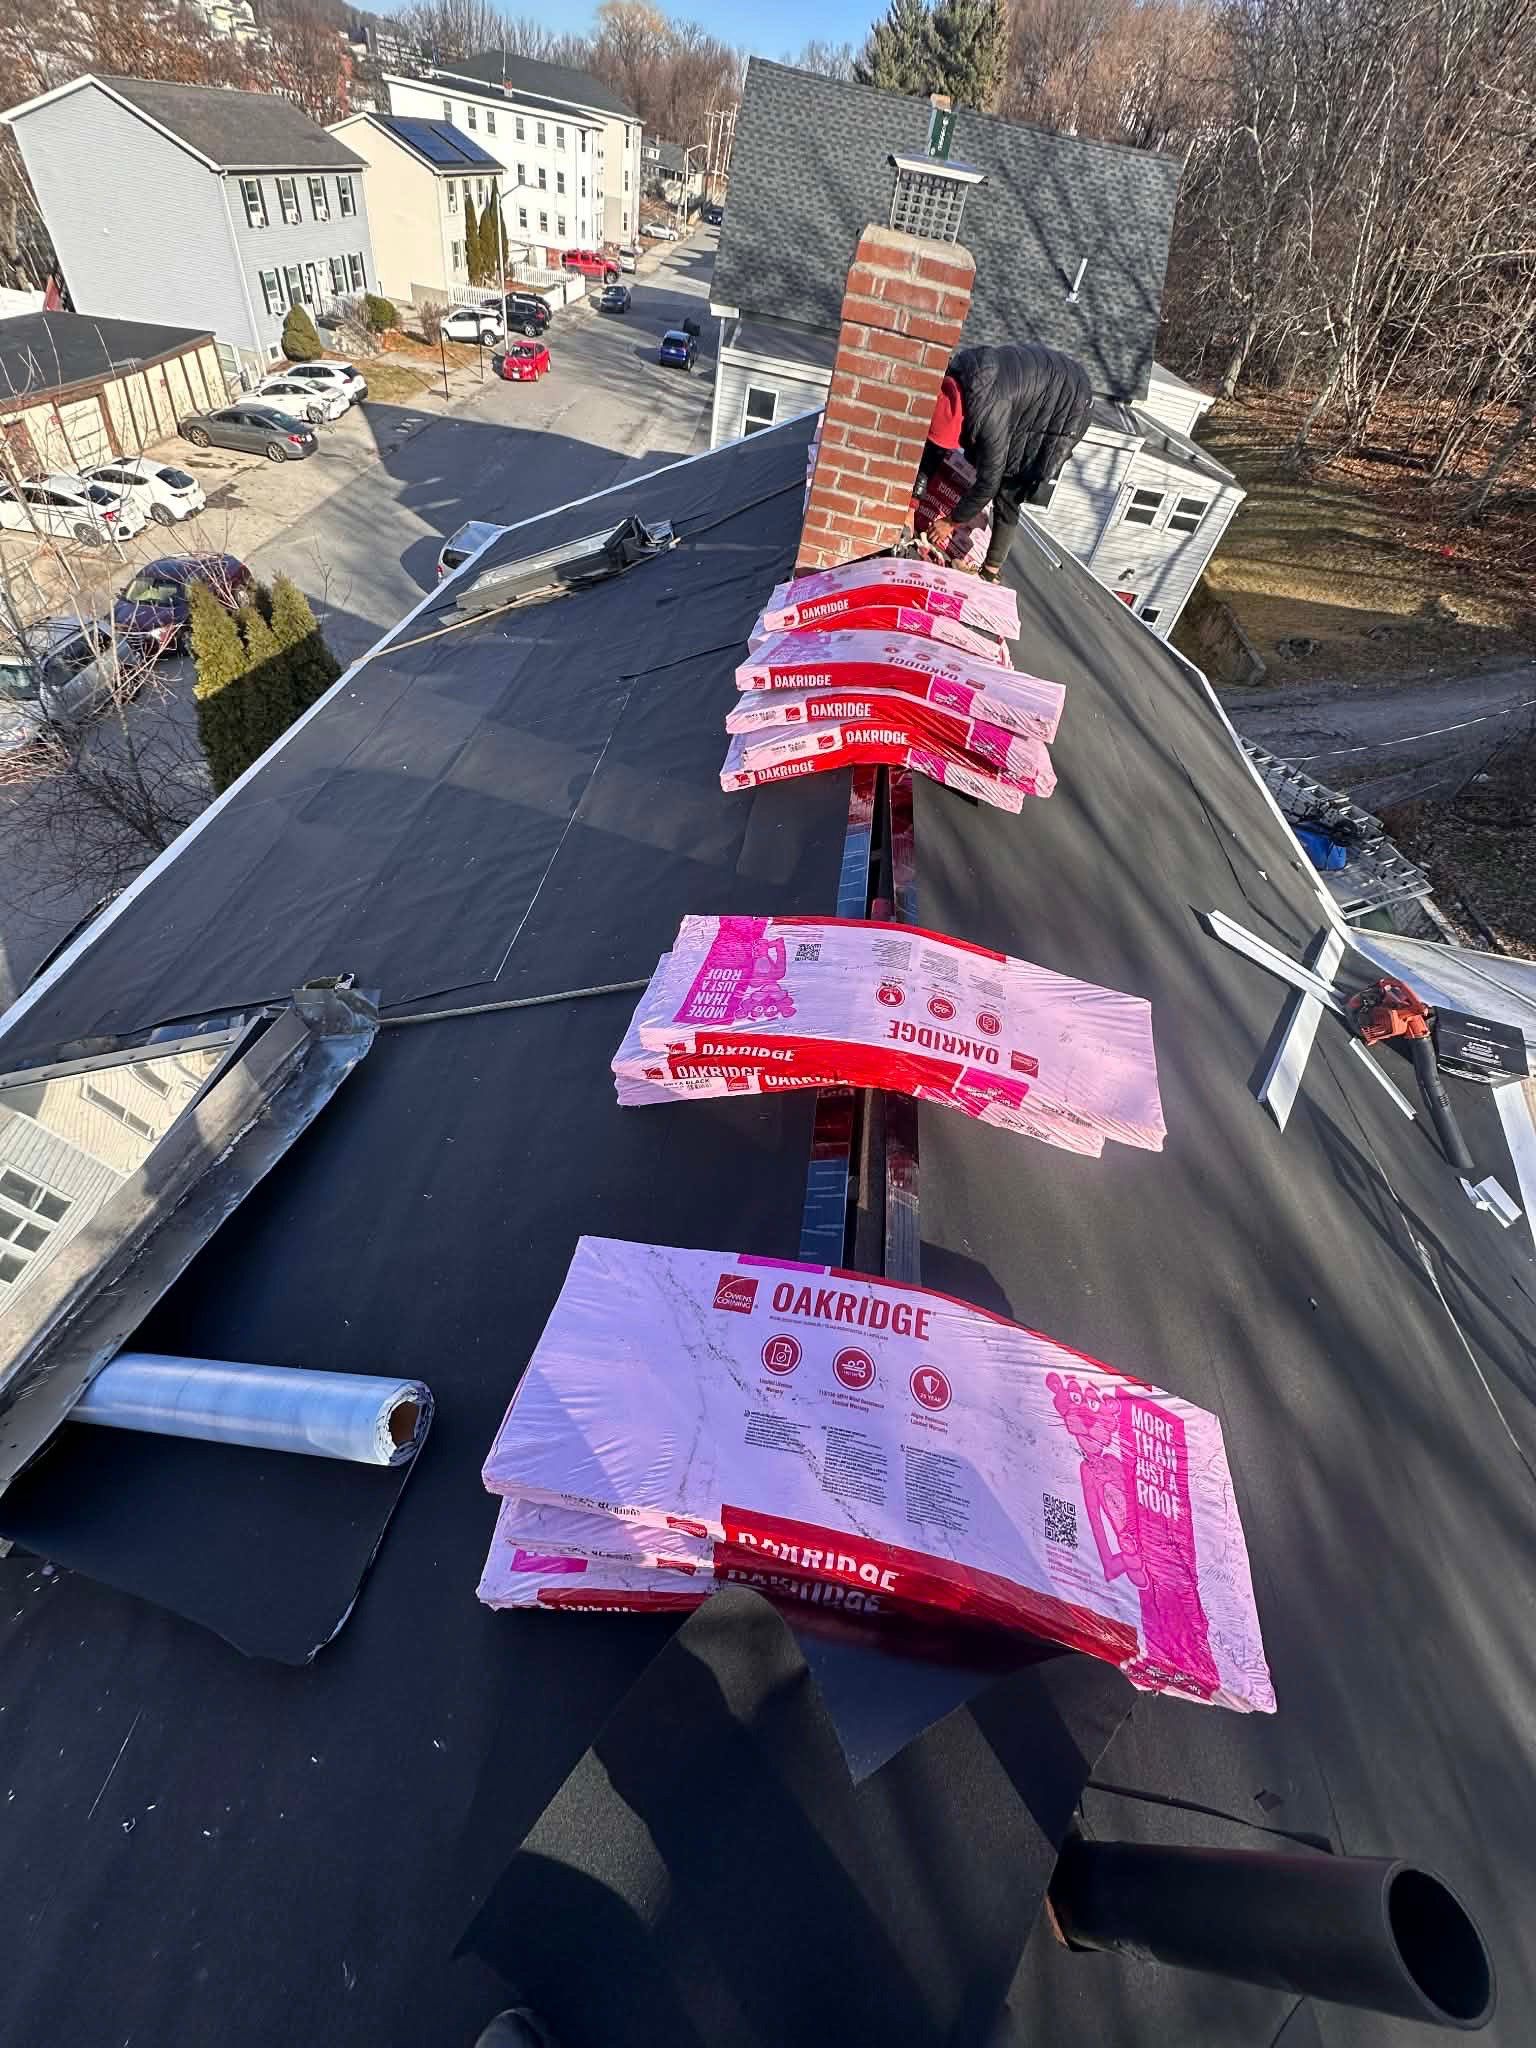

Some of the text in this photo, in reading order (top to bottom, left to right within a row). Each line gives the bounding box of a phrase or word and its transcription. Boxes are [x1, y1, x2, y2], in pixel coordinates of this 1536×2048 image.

[801, 600, 849, 620] OAKRIDGE
[888, 657, 959, 681] OAKRIDGE
[774, 674, 832, 688] OAKRIDGE
[811, 703, 871, 717] OAKRIDGE
[846, 730, 909, 745] OAKRIDGE
[757, 760, 815, 781] OAKRIDGE
[704, 968, 744, 980] ROOF
[701, 981, 736, 992] JUST A
[694, 991, 733, 1006] THAN
[687, 1005, 728, 1018] MORE
[887, 1020, 999, 1065] OAKRIDGE
[724, 1291, 753, 1303] OWENS
[772, 1282, 931, 1341] OAKRIDGE
[1131, 1402, 1175, 1443] MORE
[1134, 1429, 1178, 1474] THAN
[1136, 1458, 1179, 1495] JUST A
[1136, 1482, 1181, 1522] ROOF
